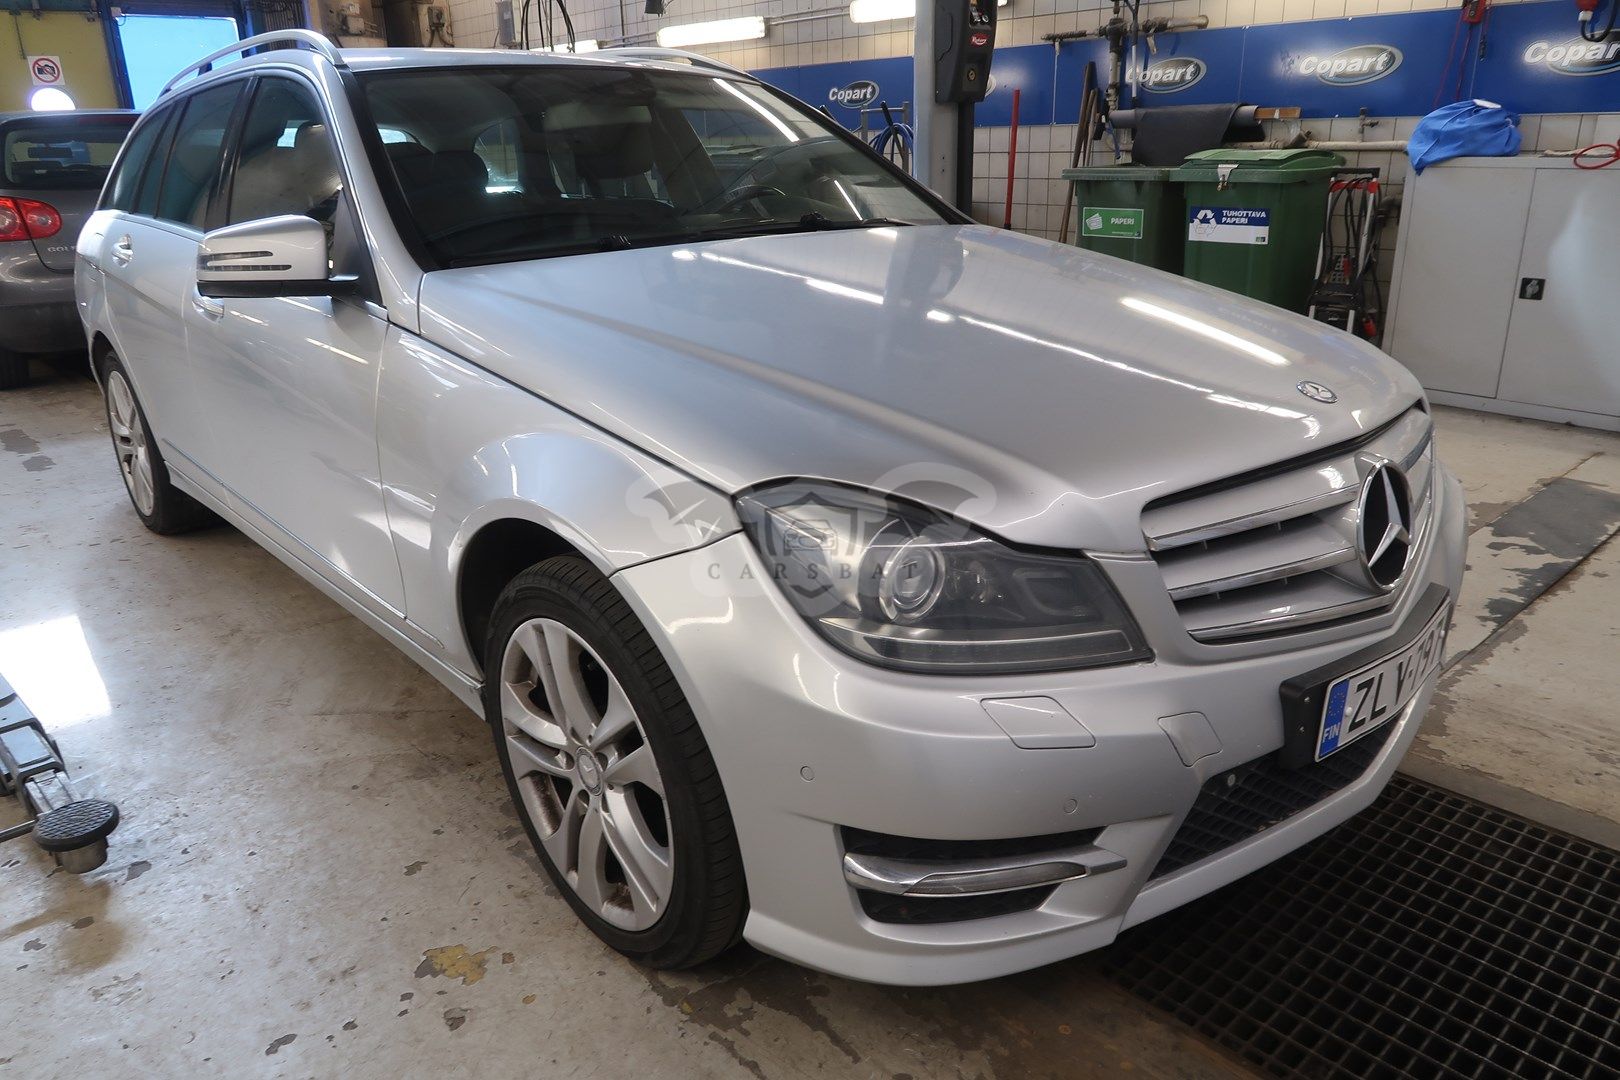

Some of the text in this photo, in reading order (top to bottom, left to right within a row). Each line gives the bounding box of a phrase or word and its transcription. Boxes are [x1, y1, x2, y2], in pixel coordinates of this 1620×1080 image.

[1300, 51, 1388, 77] Copart
[829, 86, 872, 102] Copart
[1110, 217, 1135, 225] PAPERI
[1222, 210, 1267, 218] TUHOTTAVA
[1322, 722, 1341, 743] FIN
